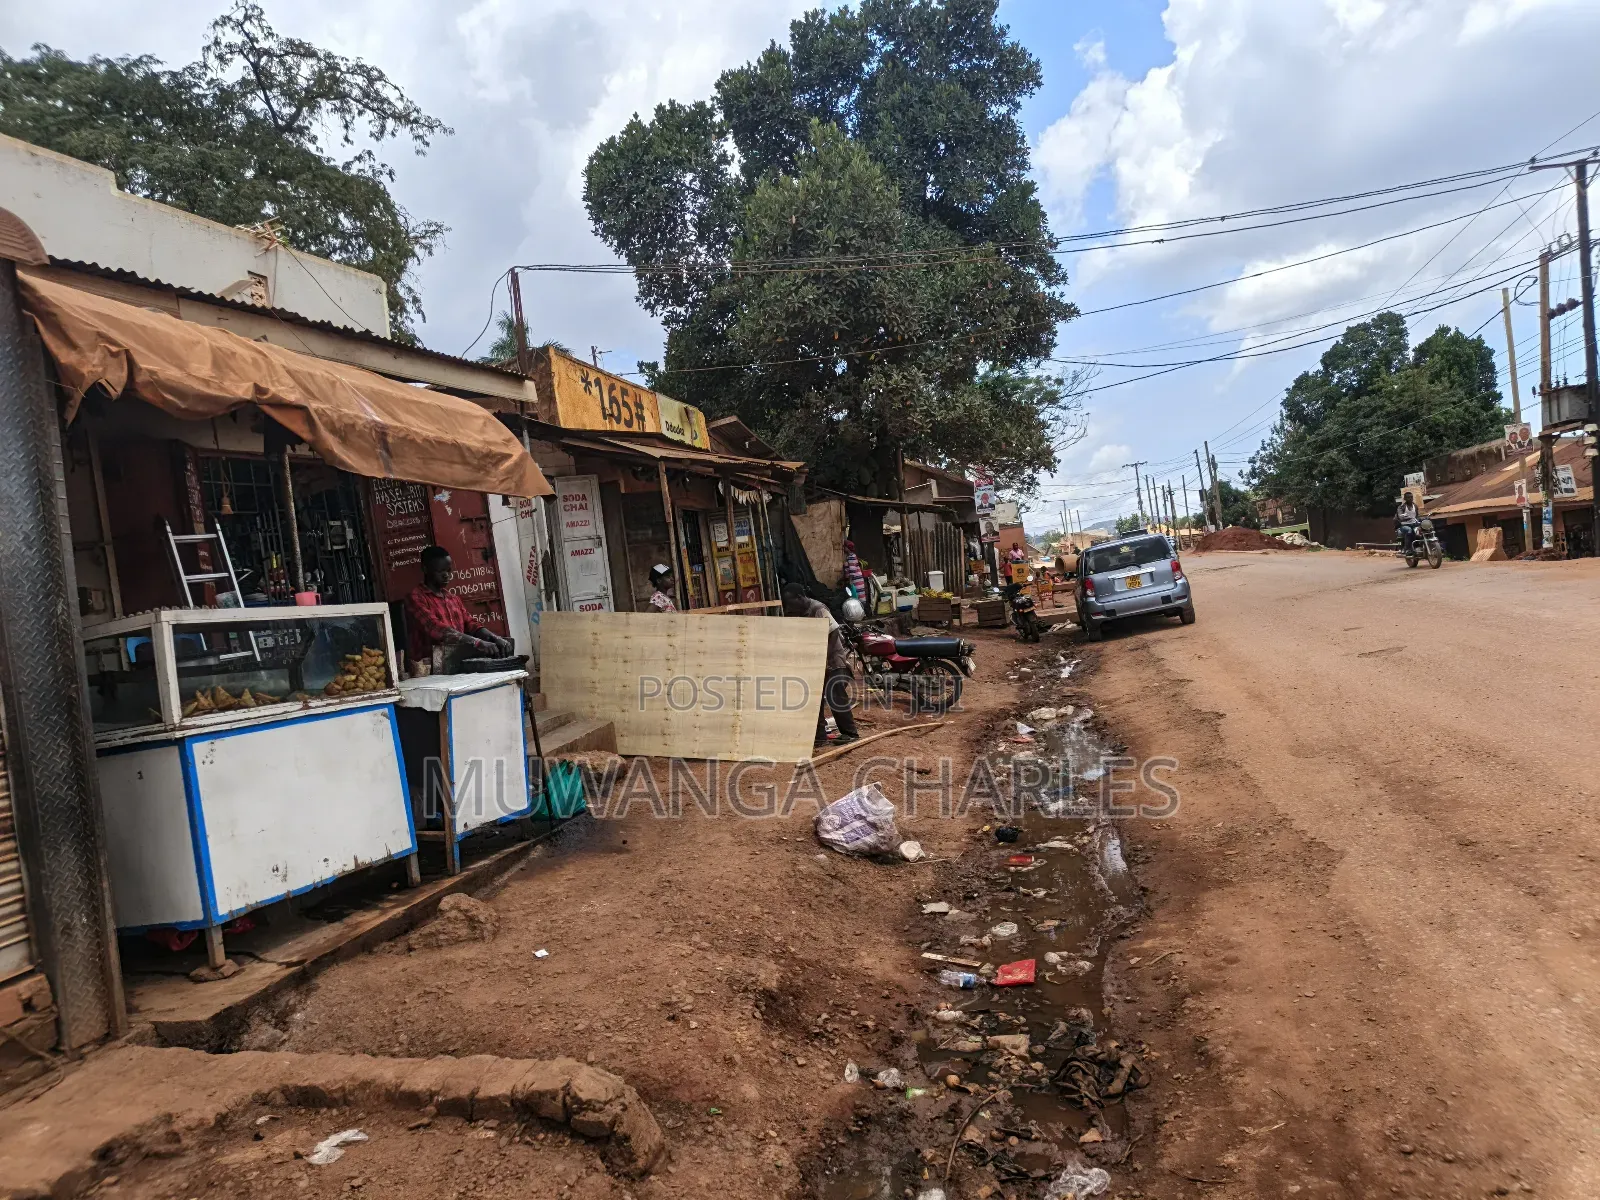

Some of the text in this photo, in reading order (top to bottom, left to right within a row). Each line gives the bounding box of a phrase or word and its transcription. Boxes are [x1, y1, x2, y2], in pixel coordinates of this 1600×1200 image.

[388, 484, 425, 503] SERITY
[562, 494, 587, 503] SODA
[386, 498, 425, 517] SYSTEMS
[520, 499, 531, 509] SOD
[563, 502, 588, 512] CHAI
[565, 519, 590, 528] AMAZZI
[570, 548, 595, 557] AMAZZI
[579, 603, 604, 612] SODA
